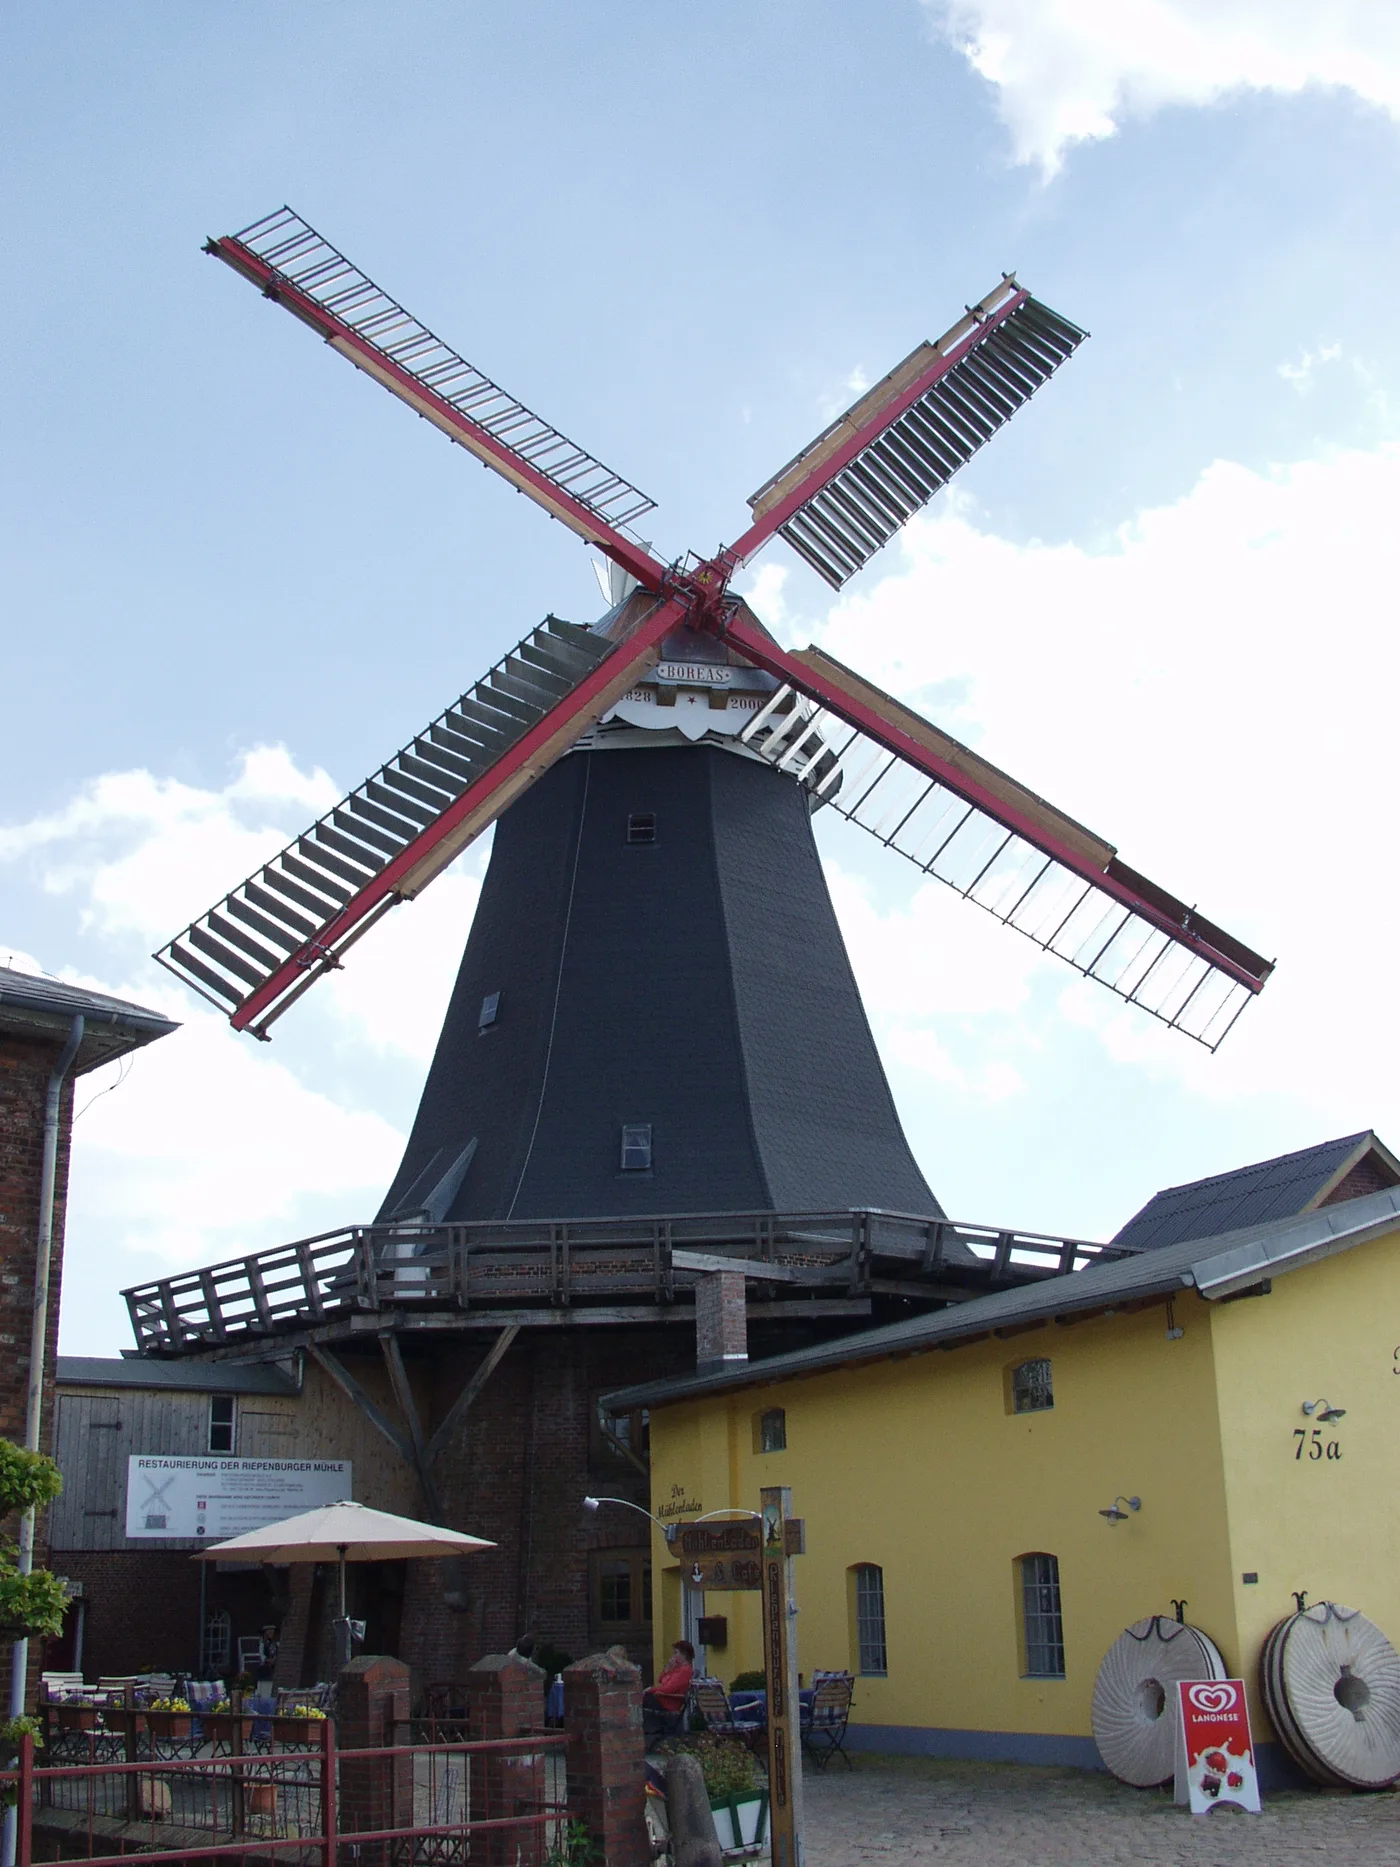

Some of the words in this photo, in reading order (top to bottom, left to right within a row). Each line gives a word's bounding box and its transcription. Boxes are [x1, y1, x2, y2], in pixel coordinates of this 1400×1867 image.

[667, 665, 724, 681] BOREAS
[621, 690, 651, 702] 828
[1293, 1428, 1343, 1460] 75a
[138, 1459, 218, 1469] RESTAURIERUNG
[220, 1461, 240, 1470] DER
[242, 1462, 312, 1471] RIEPENBURGER
[314, 1461, 344, 1472] MÜHLE
[1192, 1713, 1238, 1722] LANGNESE
